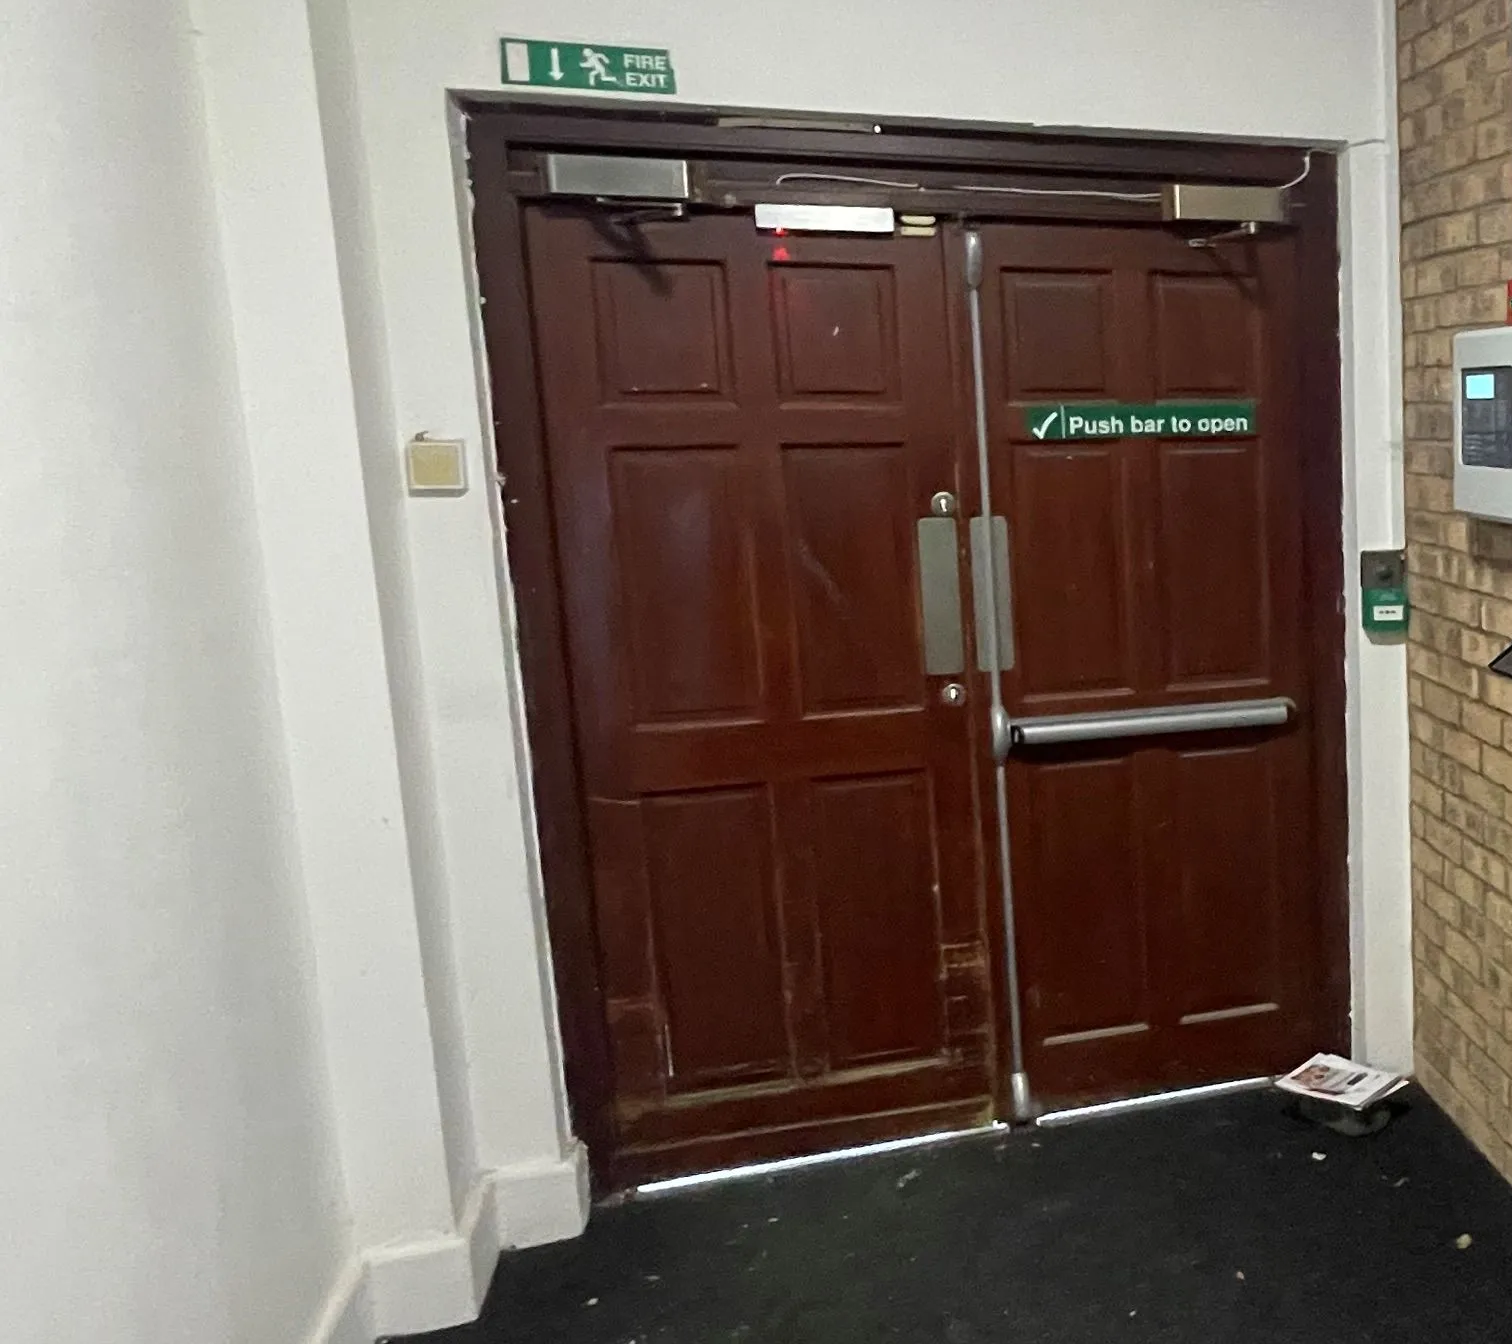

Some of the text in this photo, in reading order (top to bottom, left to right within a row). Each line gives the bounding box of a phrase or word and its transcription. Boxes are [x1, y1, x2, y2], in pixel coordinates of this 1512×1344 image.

[623, 53, 667, 71] FIRE
[625, 72, 668, 88] EXIT
[1069, 415, 1248, 435] Push bar to open
